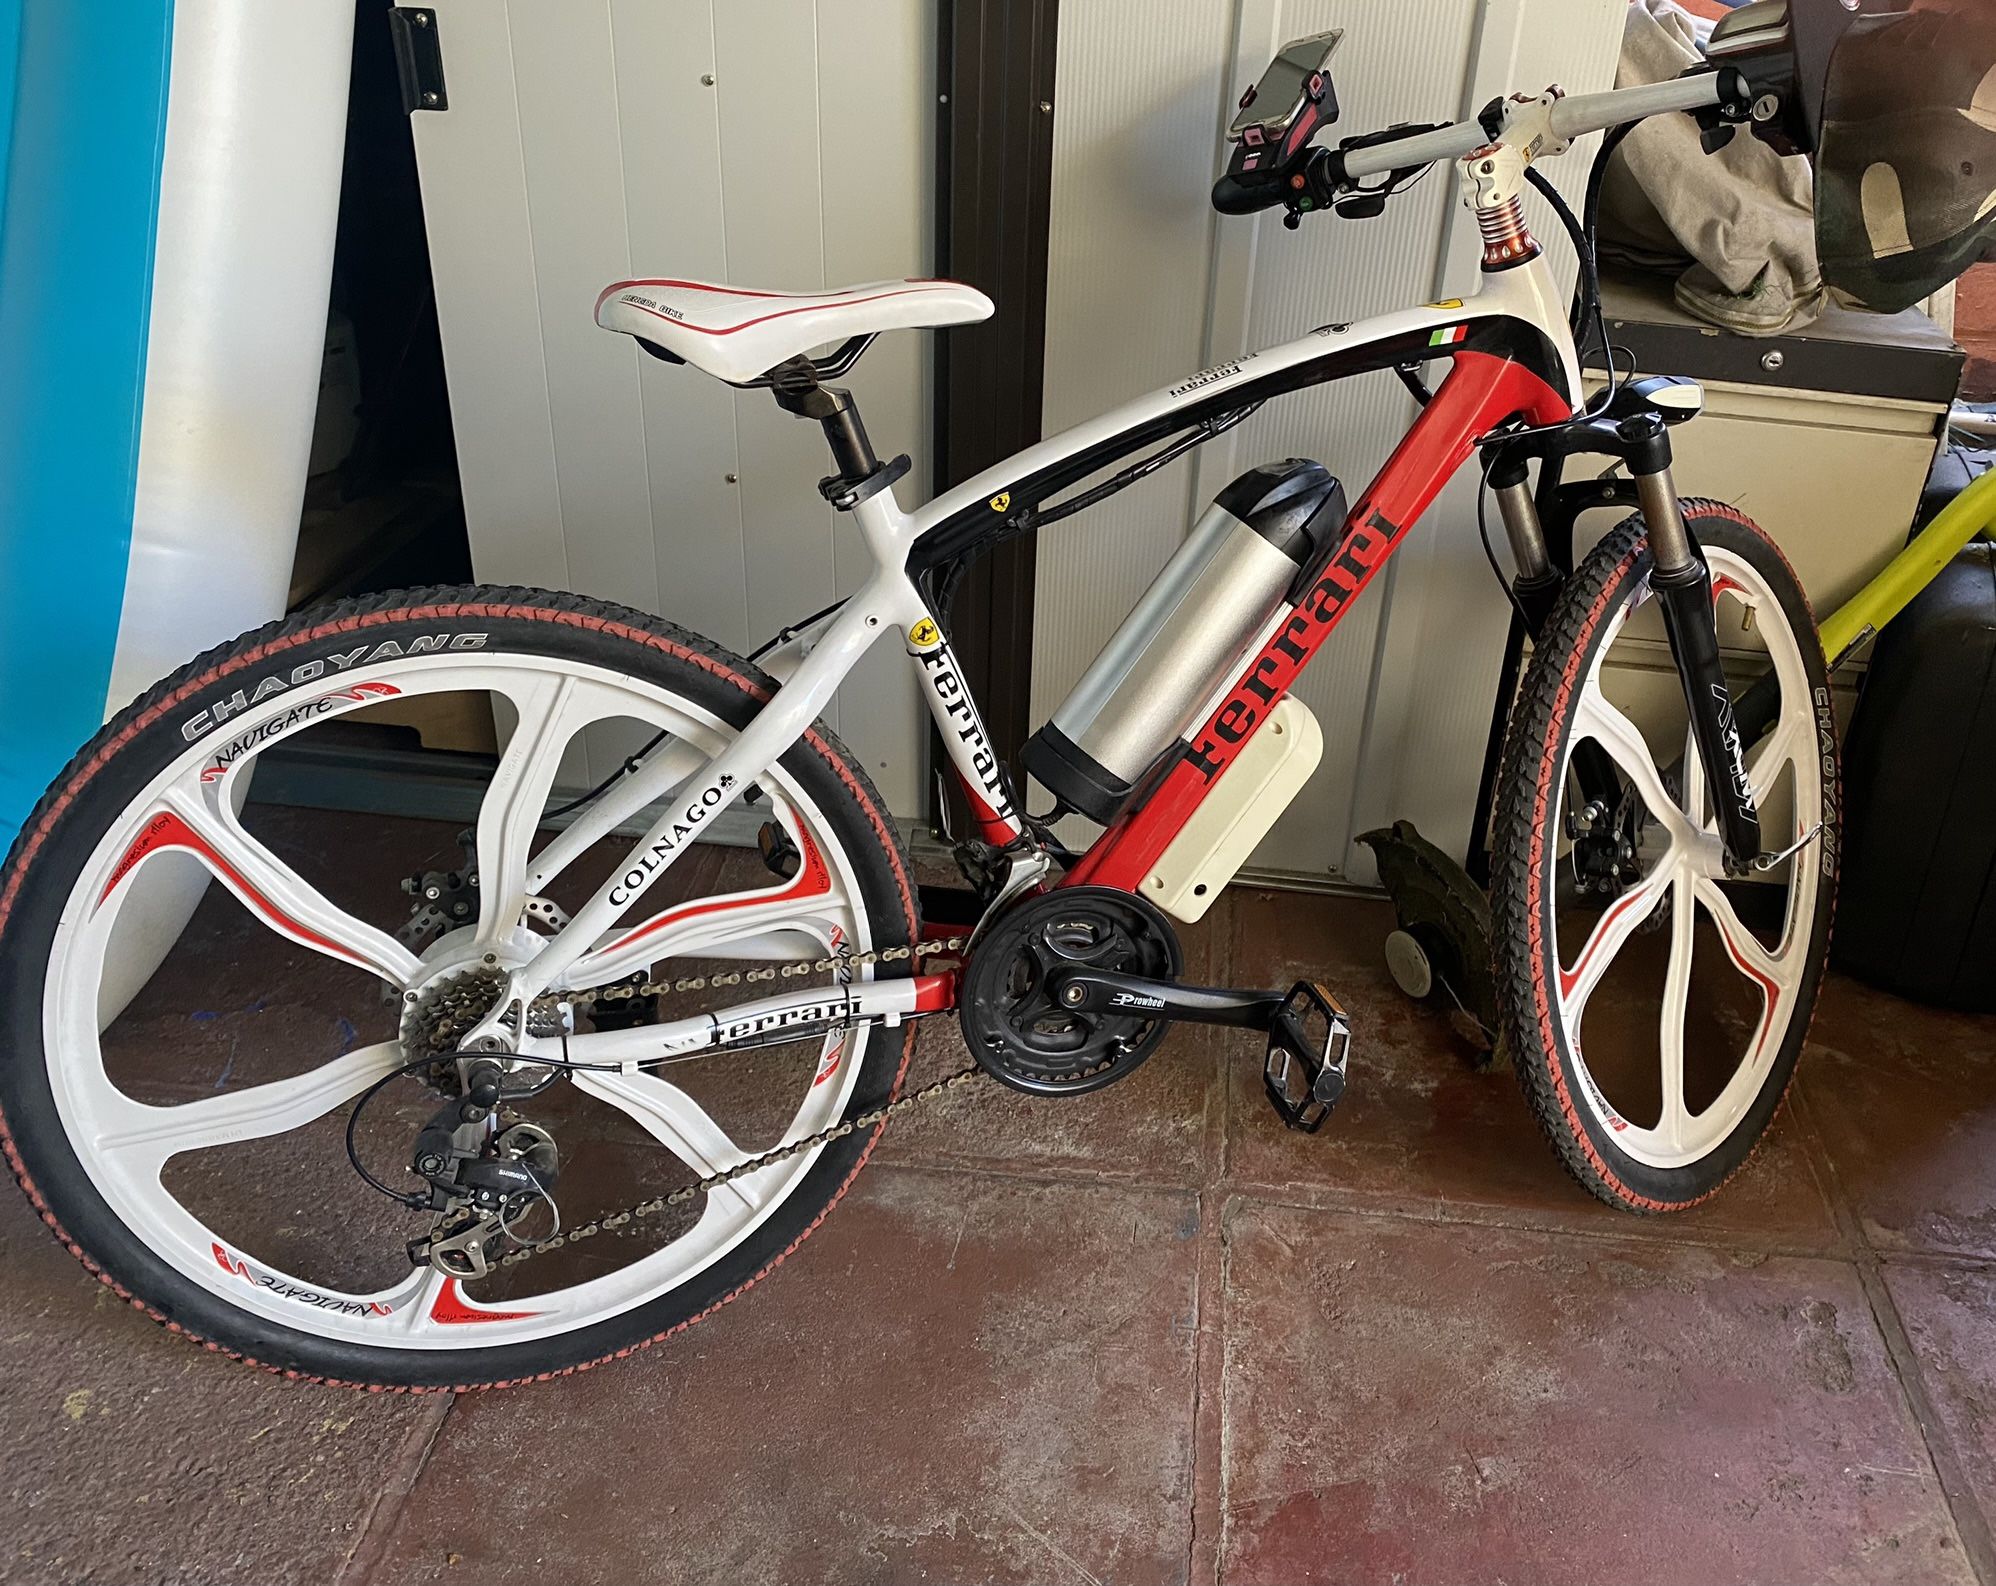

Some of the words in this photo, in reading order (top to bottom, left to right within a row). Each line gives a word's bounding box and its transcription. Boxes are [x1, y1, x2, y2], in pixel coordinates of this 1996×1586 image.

[659, 304, 684, 320] BIKE
[1168, 364, 1243, 399] Ferrari
[1184, 506, 1402, 786] Ferrari
[181, 632, 490, 742] CHAOYANG
[214, 696, 333, 769] NAVIGATE
[1813, 686, 1836, 878] CHAOYANG
[608, 786, 722, 908] COLNAGO
[1112, 992, 1166, 1008] Prowheel
[499, 1169, 528, 1181] SHIMANO
[256, 1274, 374, 1318] NAVIGATE
